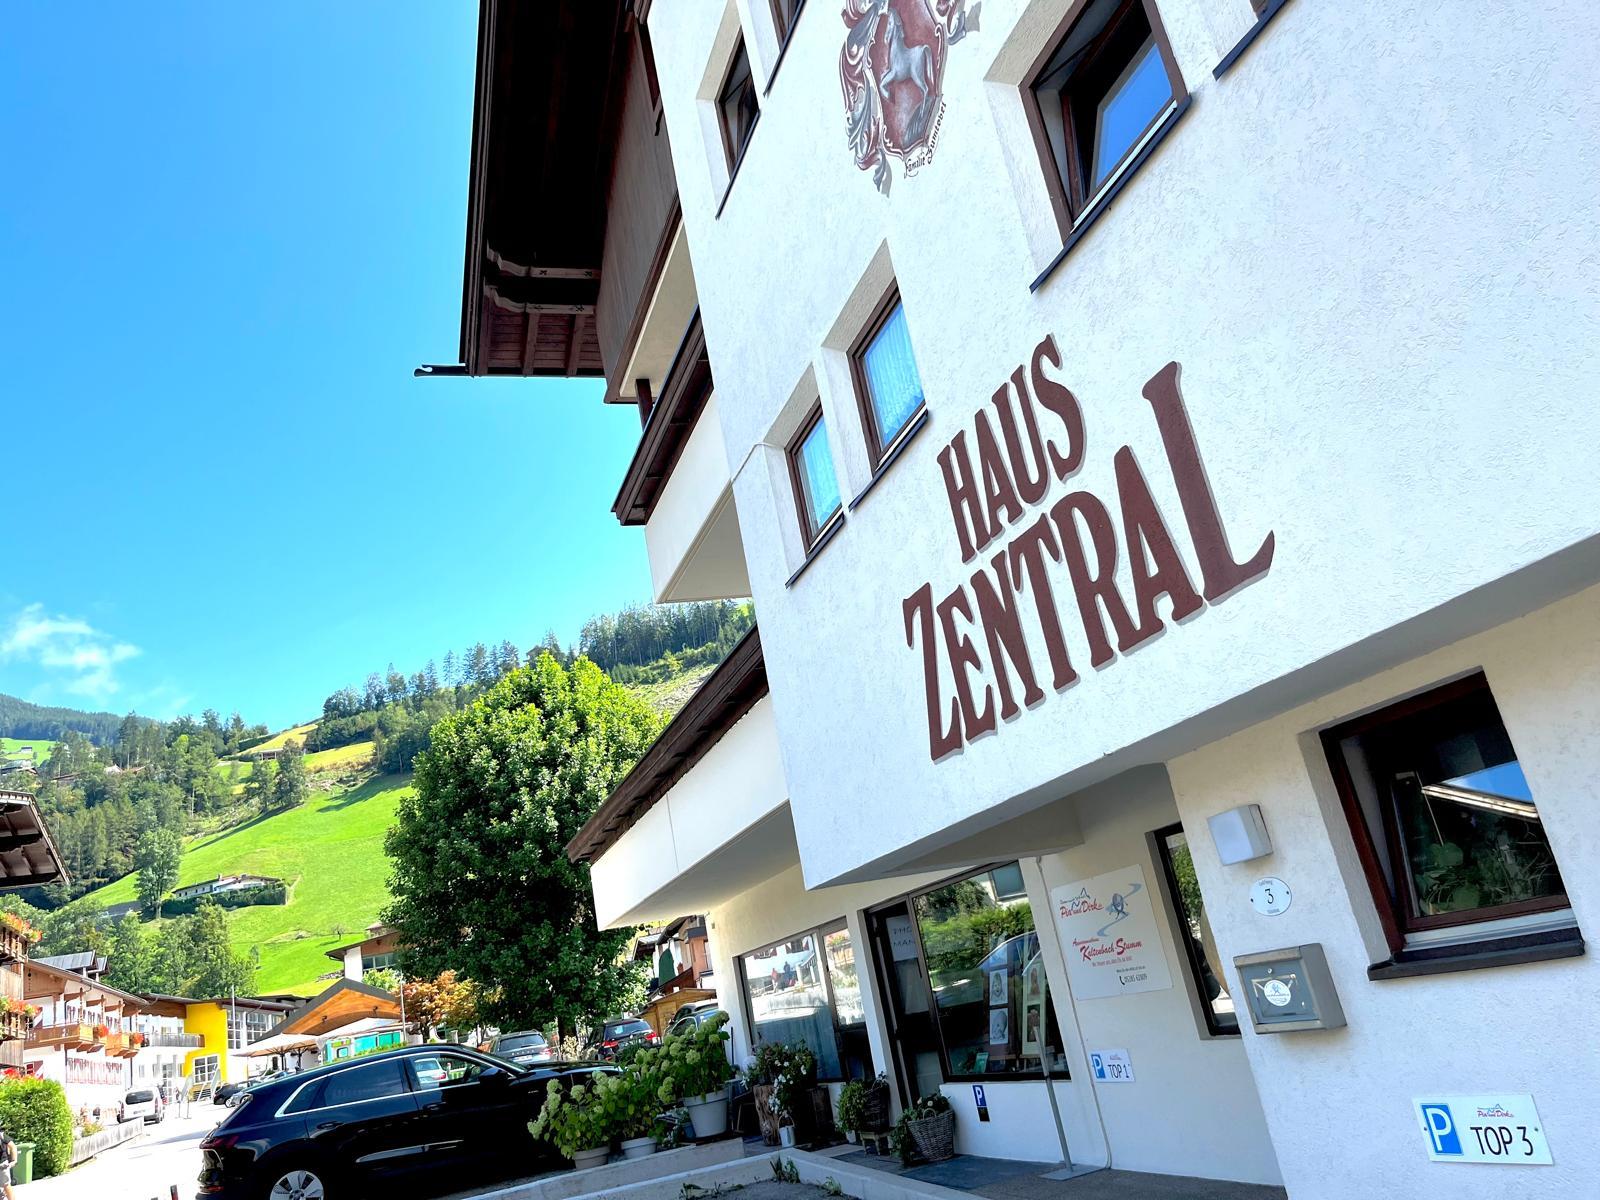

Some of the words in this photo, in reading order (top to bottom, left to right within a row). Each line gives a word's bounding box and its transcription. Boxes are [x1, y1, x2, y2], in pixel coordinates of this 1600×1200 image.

[937, 333, 1087, 564] HAUS
[903, 361, 1275, 764] ZENTRAL
[1264, 888, 1275, 905] 3
[1093, 1056, 1102, 1078] P
[1107, 1064, 1122, 1078] TOP
[1123, 1064, 1130, 1078] 1
[975, 1086, 983, 1105] P
[1425, 1107, 1452, 1152] P
[1469, 1126, 1513, 1156] TOP
[1516, 1126, 1534, 1156] 3
